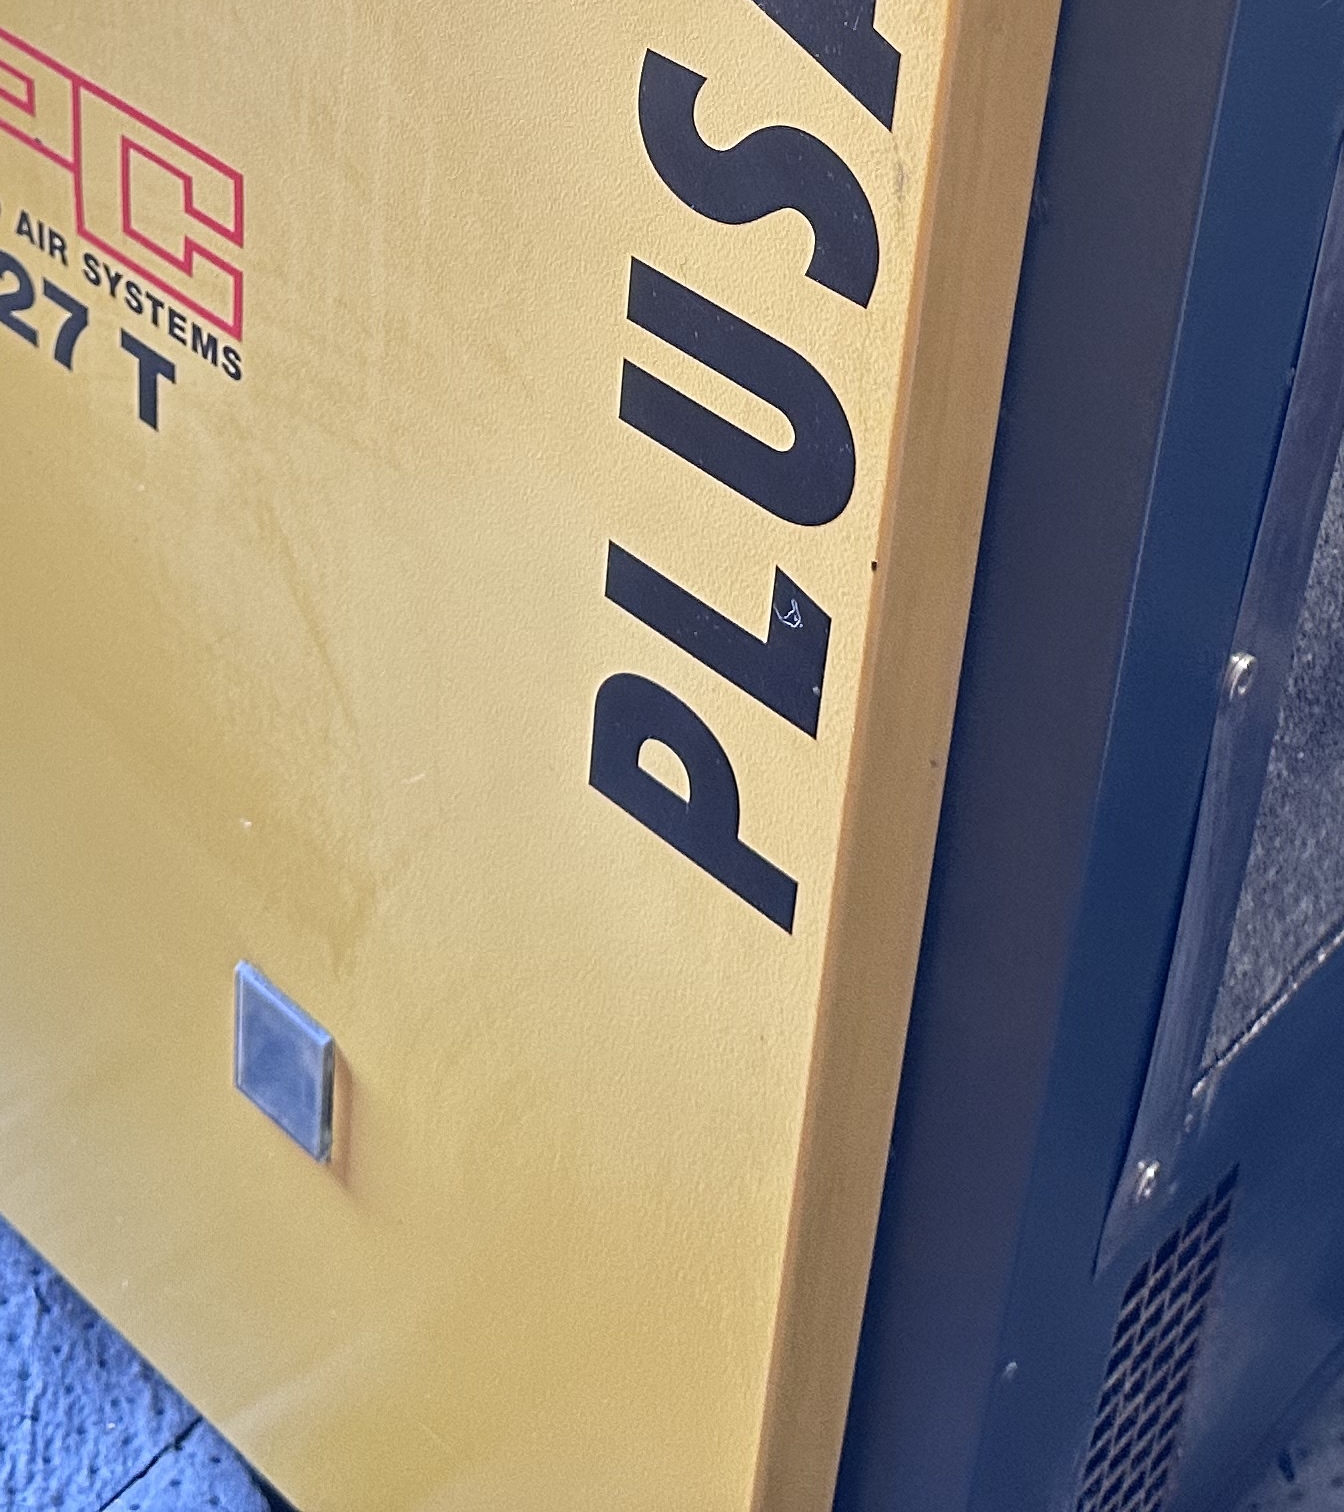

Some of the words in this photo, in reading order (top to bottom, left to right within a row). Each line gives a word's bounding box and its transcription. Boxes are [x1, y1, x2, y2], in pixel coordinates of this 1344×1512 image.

[15, 209, 69, 268] AIR
[82, 251, 244, 382] SYSTEMS
[119, 327, 177, 433] T
